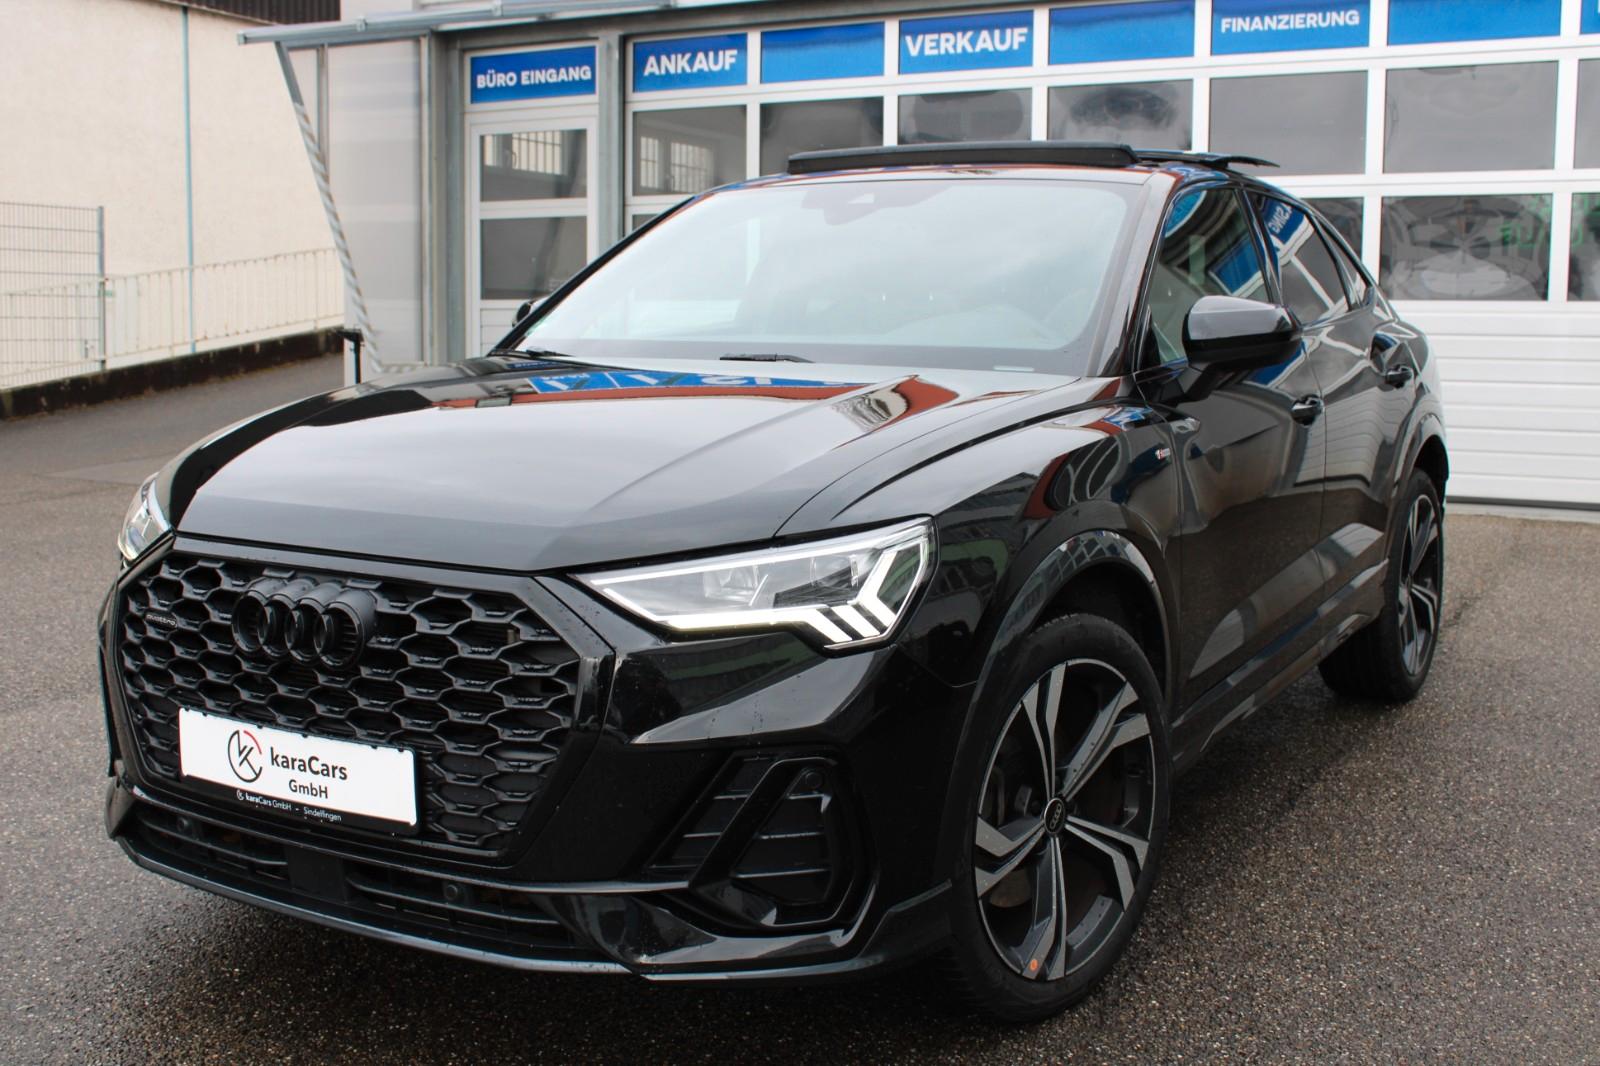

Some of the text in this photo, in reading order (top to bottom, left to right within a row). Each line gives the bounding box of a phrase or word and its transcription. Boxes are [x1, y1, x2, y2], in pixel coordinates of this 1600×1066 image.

[1221, 9, 1360, 33] FINANZIERUNG
[904, 27, 1028, 57] VERKAUF
[643, 49, 738, 76] ANKAUF
[476, 65, 592, 89] BÜRO EINGANG
[270, 746, 348, 781] karaCars
[288, 779, 329, 799] GmbH
[245, 792, 272, 806] karaCars
[272, 799, 292, 812] GmbH
[303, 806, 342, 822] Sindelfingen
